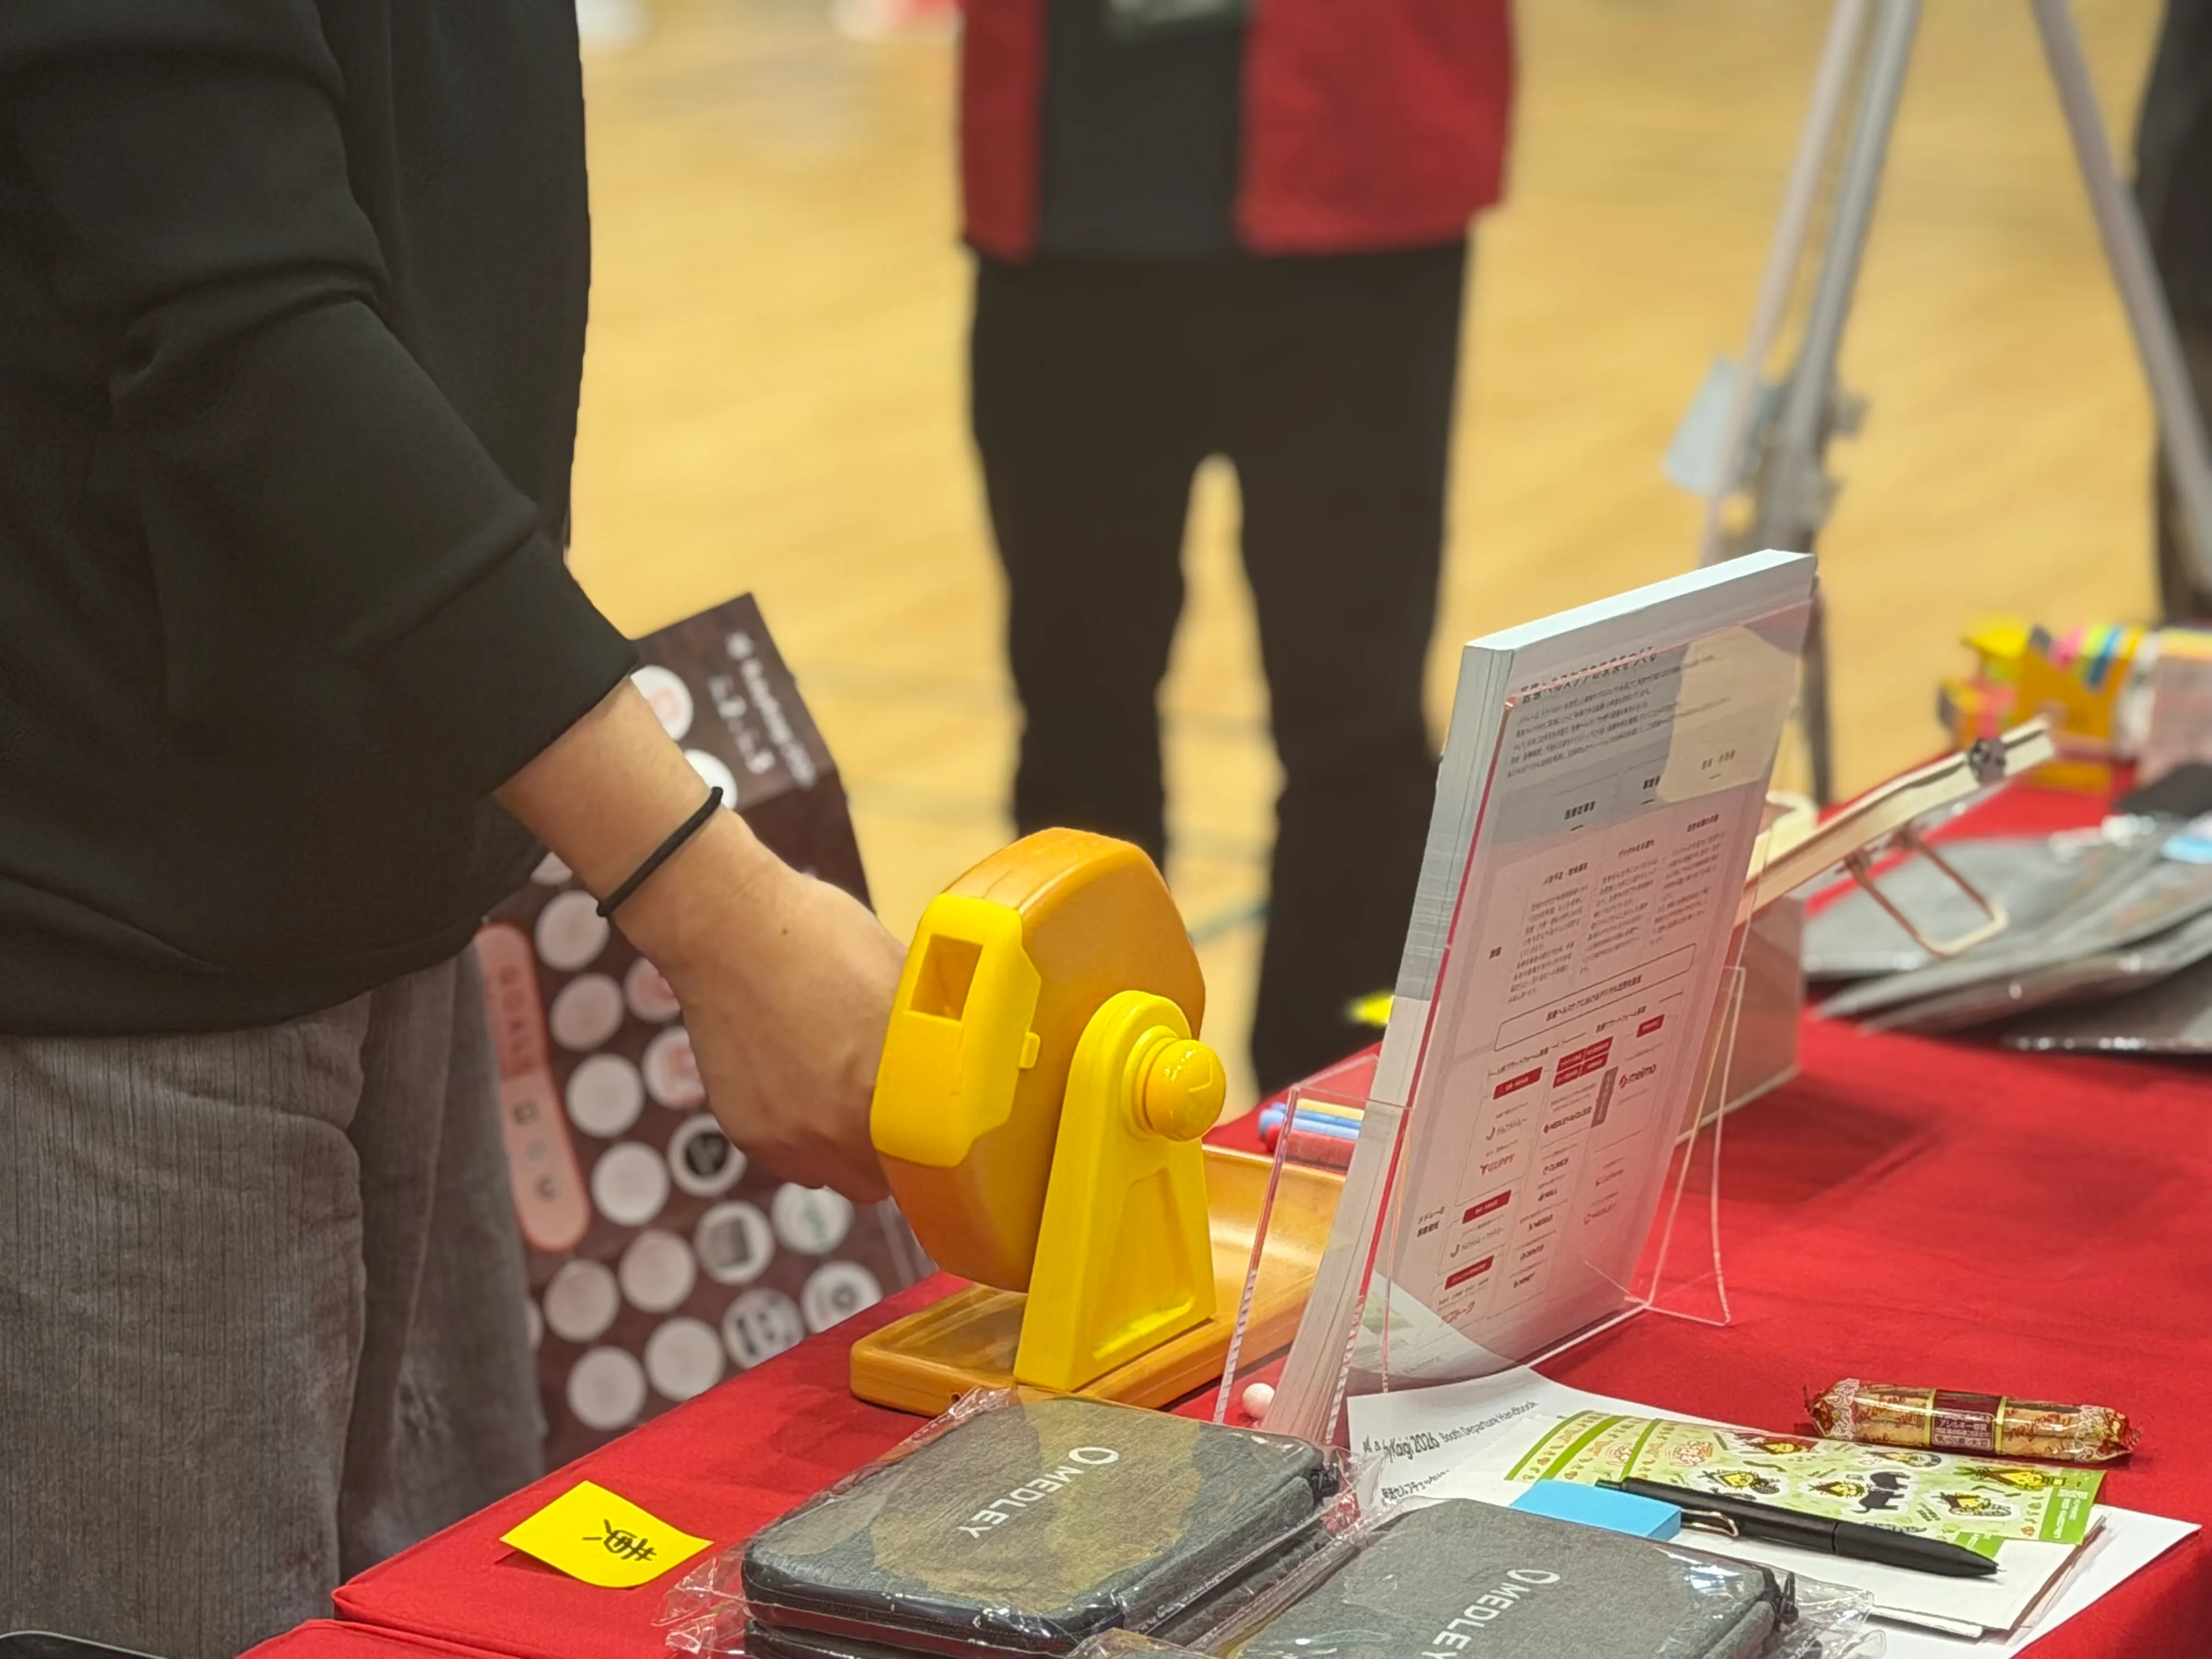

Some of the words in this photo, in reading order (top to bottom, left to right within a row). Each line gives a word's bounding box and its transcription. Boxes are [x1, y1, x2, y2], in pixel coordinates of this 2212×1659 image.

[1410, 1431, 1441, 1454] 2026
[957, 1465, 1085, 1539] MEDLEY
[1421, 1582, 1531, 1659] MEDLEY
